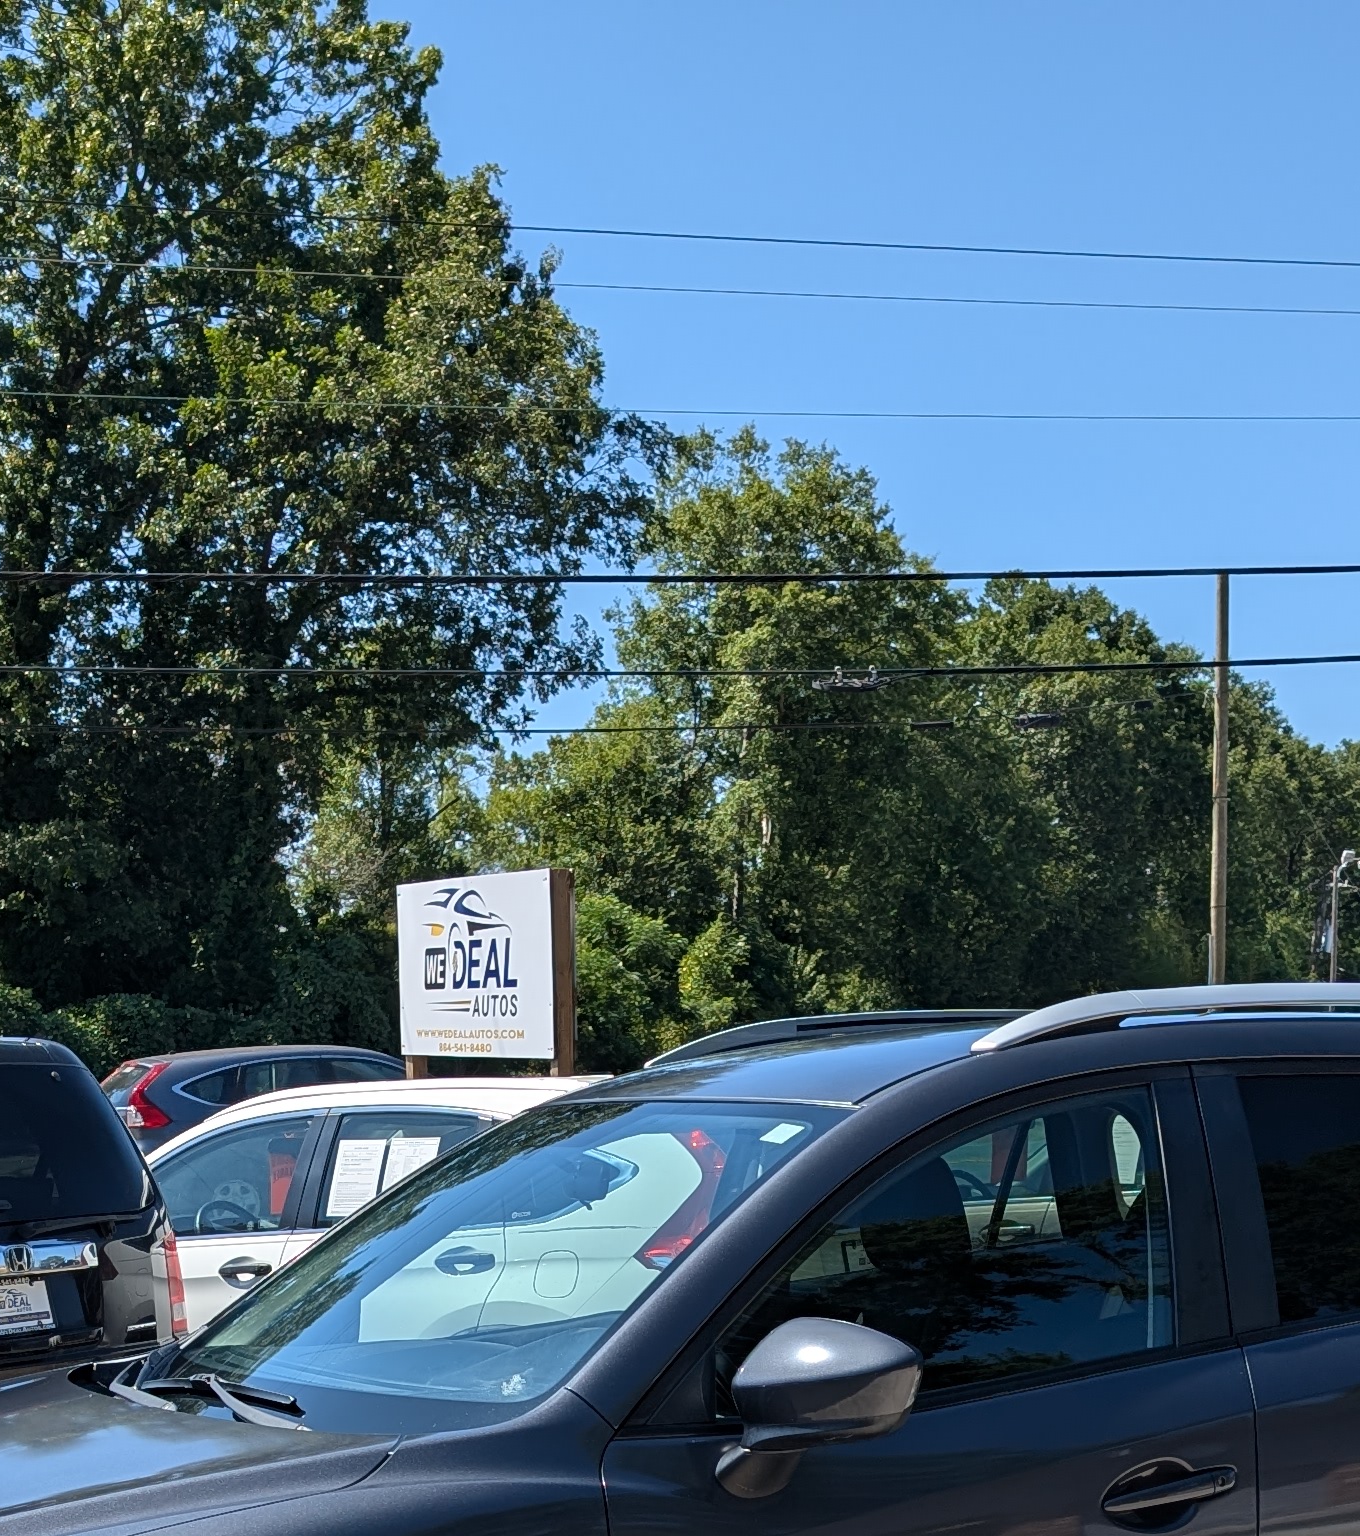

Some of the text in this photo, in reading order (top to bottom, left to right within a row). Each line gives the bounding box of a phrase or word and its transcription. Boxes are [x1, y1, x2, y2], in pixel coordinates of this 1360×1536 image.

[425, 937, 518, 990] WE DEAL
[471, 994, 518, 1018] AUTOS
[416, 1029, 525, 1039] WWW.WEDEALAUTOS.COM
[7, 1296, 31, 1308] DEAL
